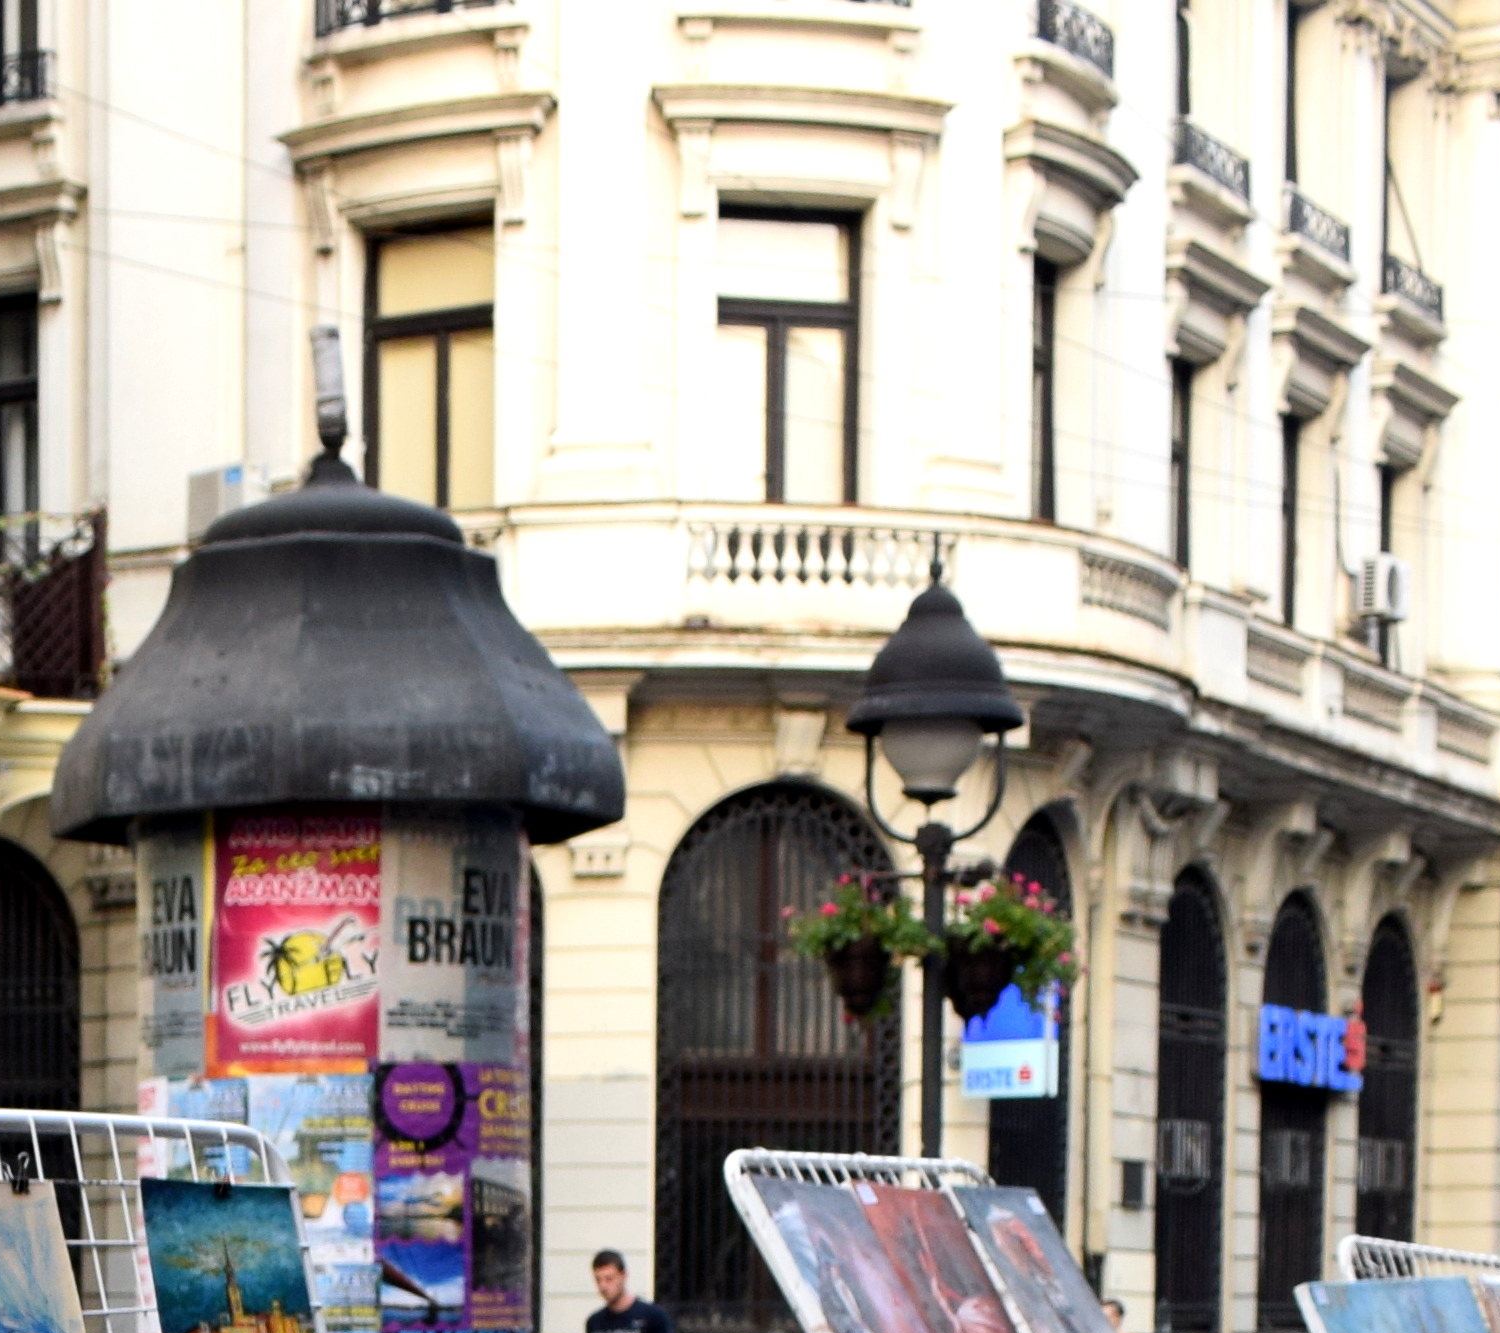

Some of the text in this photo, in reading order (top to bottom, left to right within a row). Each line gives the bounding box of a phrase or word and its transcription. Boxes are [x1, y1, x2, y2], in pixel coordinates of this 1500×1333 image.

[463, 868, 511, 915] EVA
[408, 917, 512, 967] BRAUN
[227, 947, 380, 1013] FLY FLY
[264, 984, 345, 1021] TRAVEL
[1258, 1004, 1363, 1091] ERSTE
